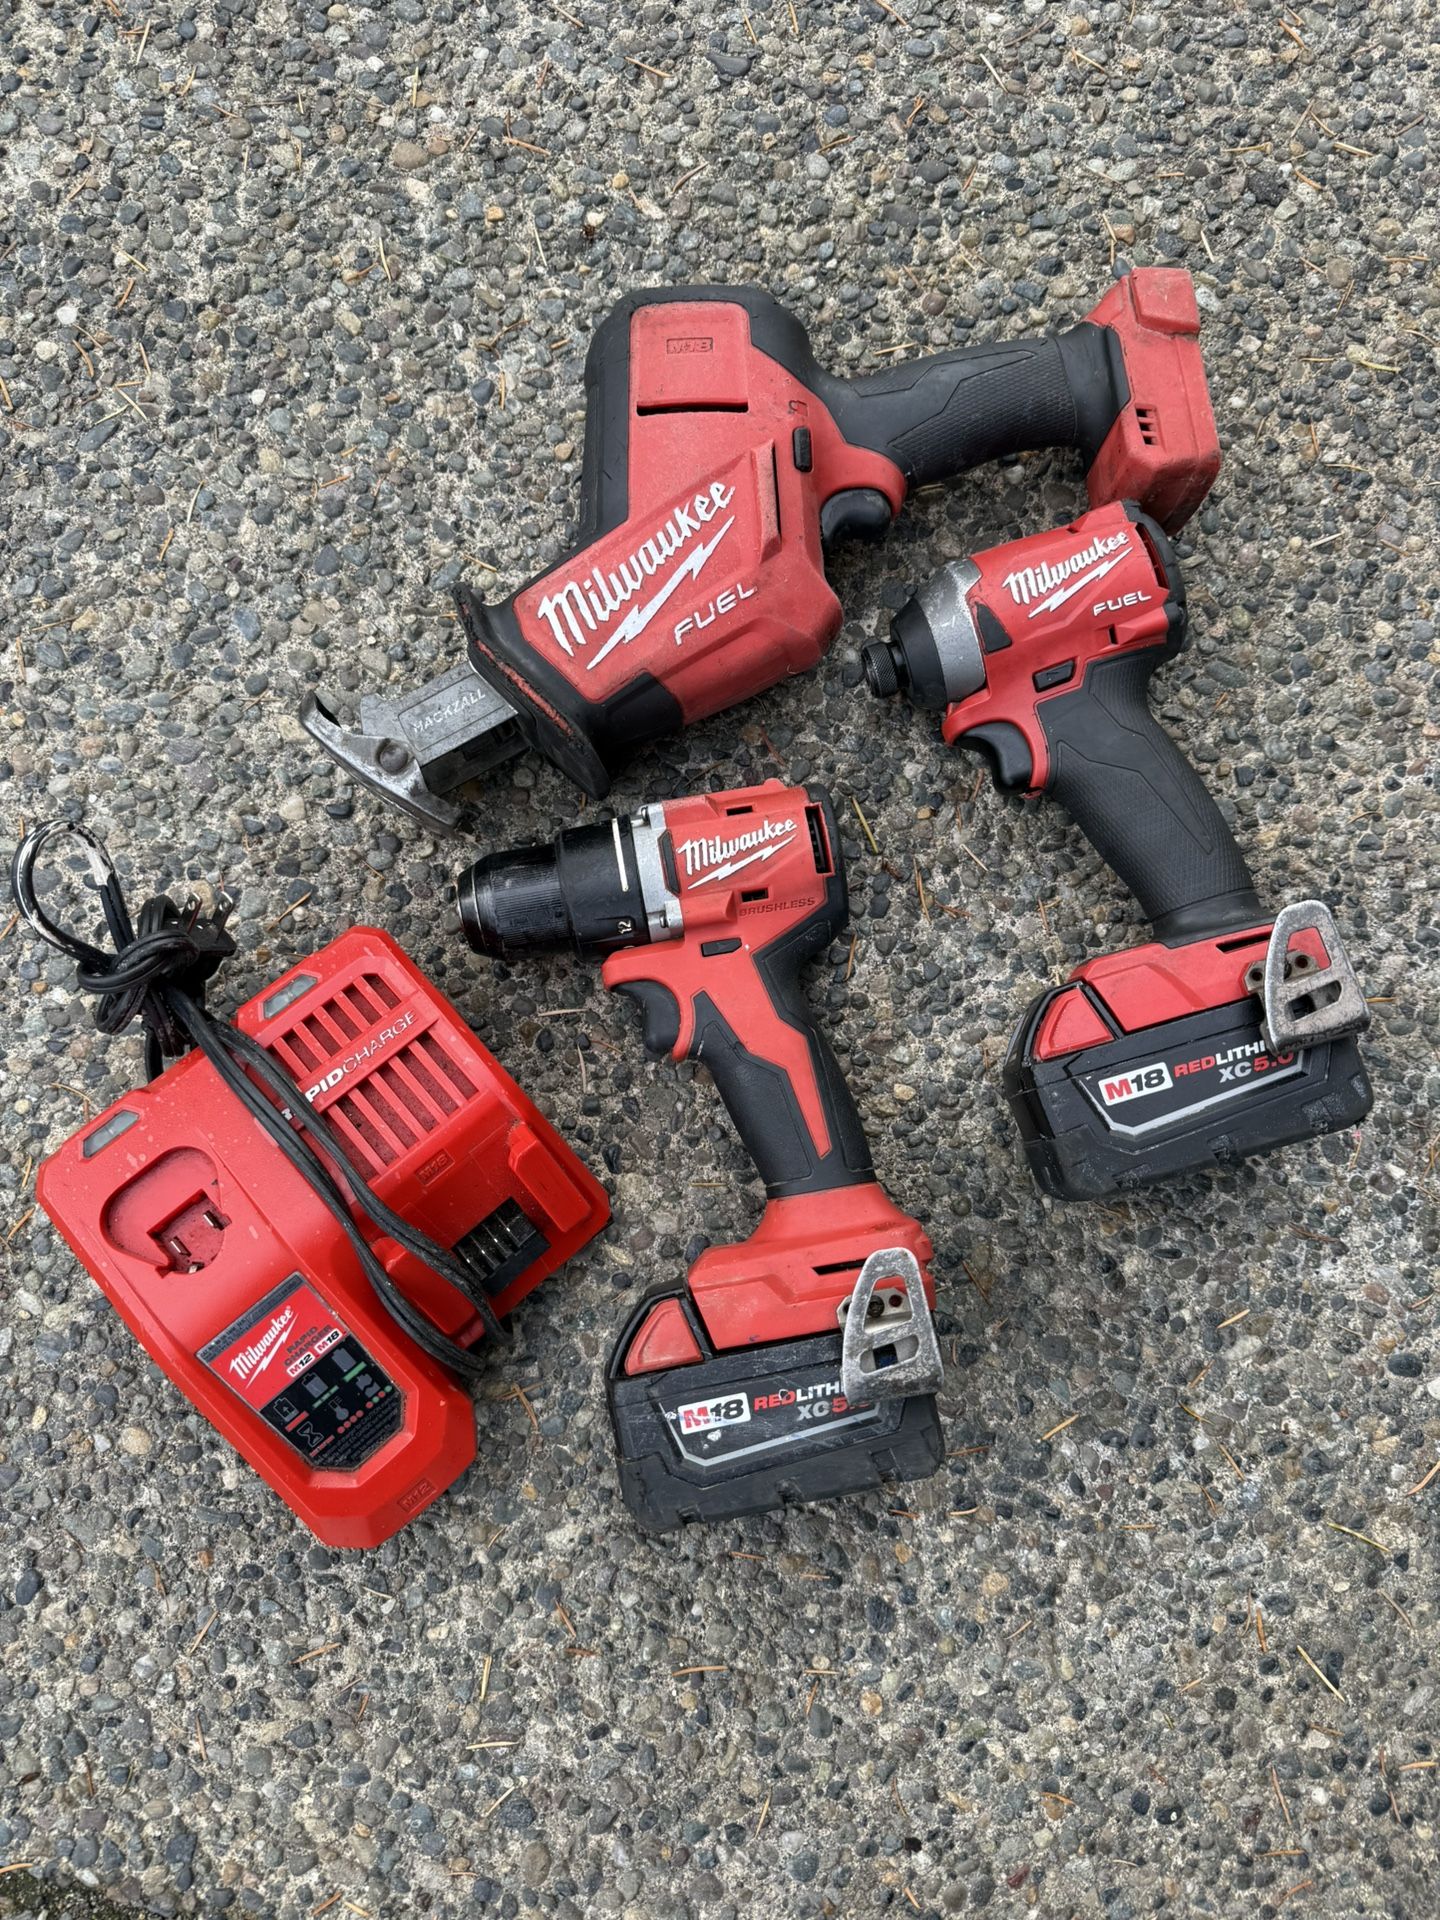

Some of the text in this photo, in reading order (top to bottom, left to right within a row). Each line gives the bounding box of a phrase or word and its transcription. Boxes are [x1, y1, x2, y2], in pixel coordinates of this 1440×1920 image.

[537, 481, 735, 657] Milwaukee
[1002, 531, 1130, 605] Milwaukee
[674, 582, 758, 645] FUEL
[1093, 590, 1152, 617] FUEL
[677, 818, 798, 876] Milwaukee
[618, 920, 632, 935] 12
[739, 897, 816, 917] BRUSHLESS
[281, 1010, 419, 1121] PIDCHARGE
[1104, 1040, 1266, 1101] M18 REDLITHI
[228, 1308, 294, 1380] Milwaukee
[289, 1330, 340, 1375] M12 M18
[683, 1399, 744, 1429] M18
